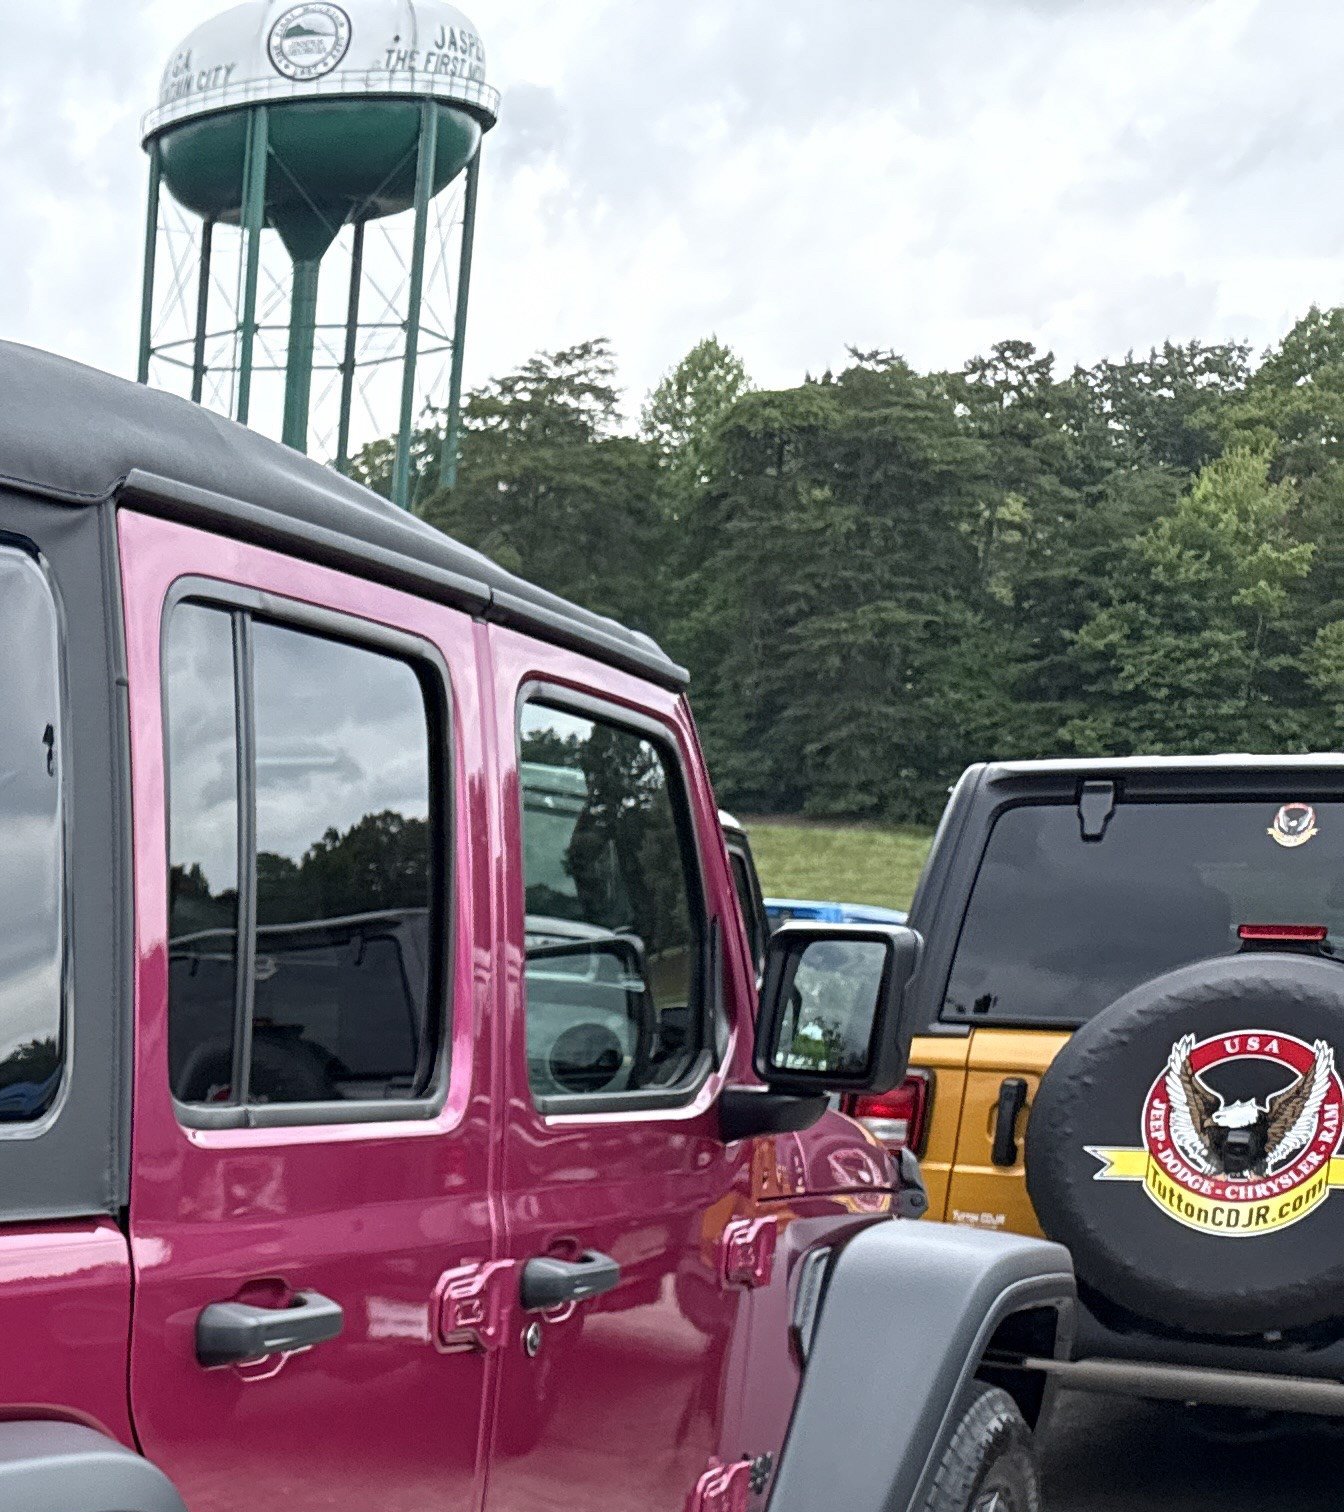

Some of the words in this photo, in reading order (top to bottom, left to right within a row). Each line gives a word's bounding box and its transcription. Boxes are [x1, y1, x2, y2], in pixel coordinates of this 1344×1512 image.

[196, 62, 238, 91] CITY
[385, 49, 419, 71] THE
[424, 52, 467, 78] FIRST
[1223, 1036, 1280, 1054] USA
[1149, 1097, 1166, 1141] JEEP
[1158, 1148, 1212, 1196] DODGE
[1224, 1153, 1324, 1200] CHRYSLER
[1317, 1102, 1340, 1145] RAM
[1150, 1164, 1324, 1229] TuttonCDJR.com
